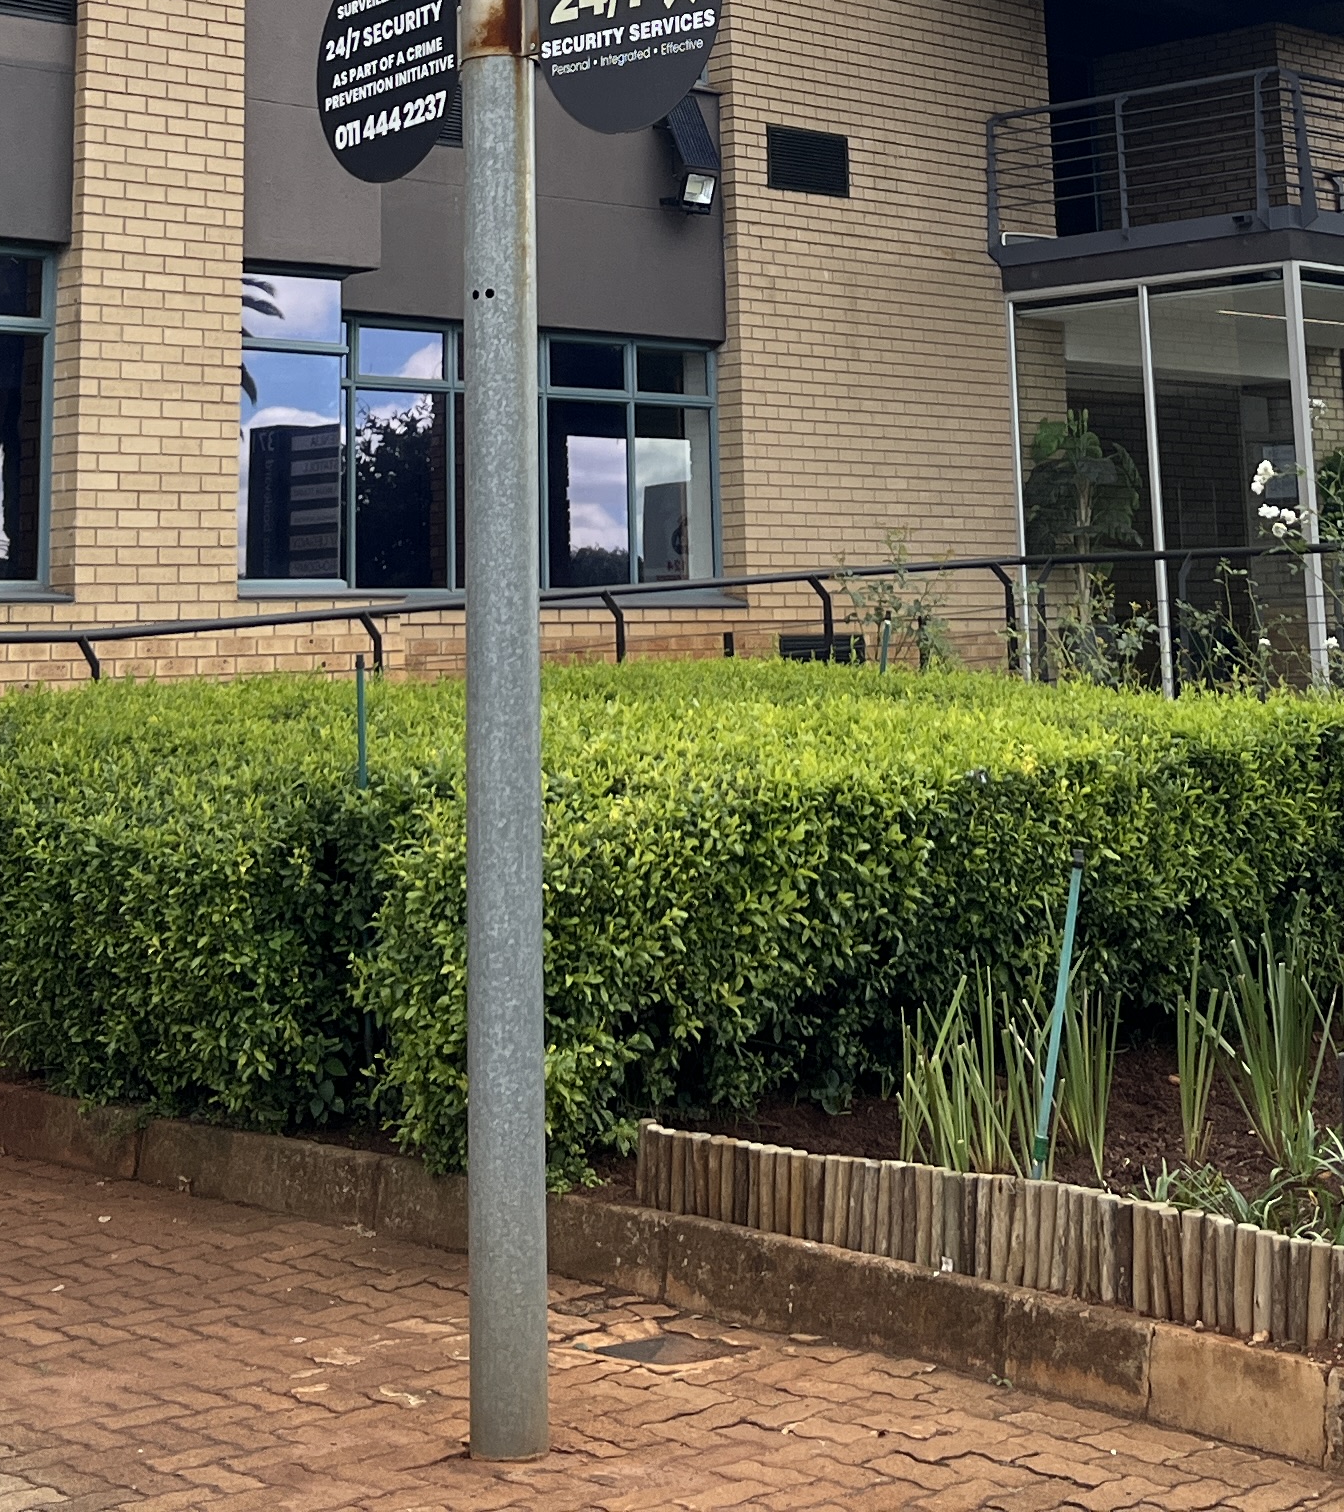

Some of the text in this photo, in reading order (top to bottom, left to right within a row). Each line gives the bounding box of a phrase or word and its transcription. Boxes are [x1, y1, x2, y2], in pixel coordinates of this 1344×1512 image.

[326, 0, 443, 62] 24/7 SECURITY
[542, 8, 716, 58] SECURITY SERVICES
[552, 38, 704, 76] Personal Integrated Effective
[325, 54, 454, 112] PREVENTION INITIATIVE
[332, 36, 443, 88] AS PART OF A CRIME
[334, 90, 447, 150] 011 444 2237
